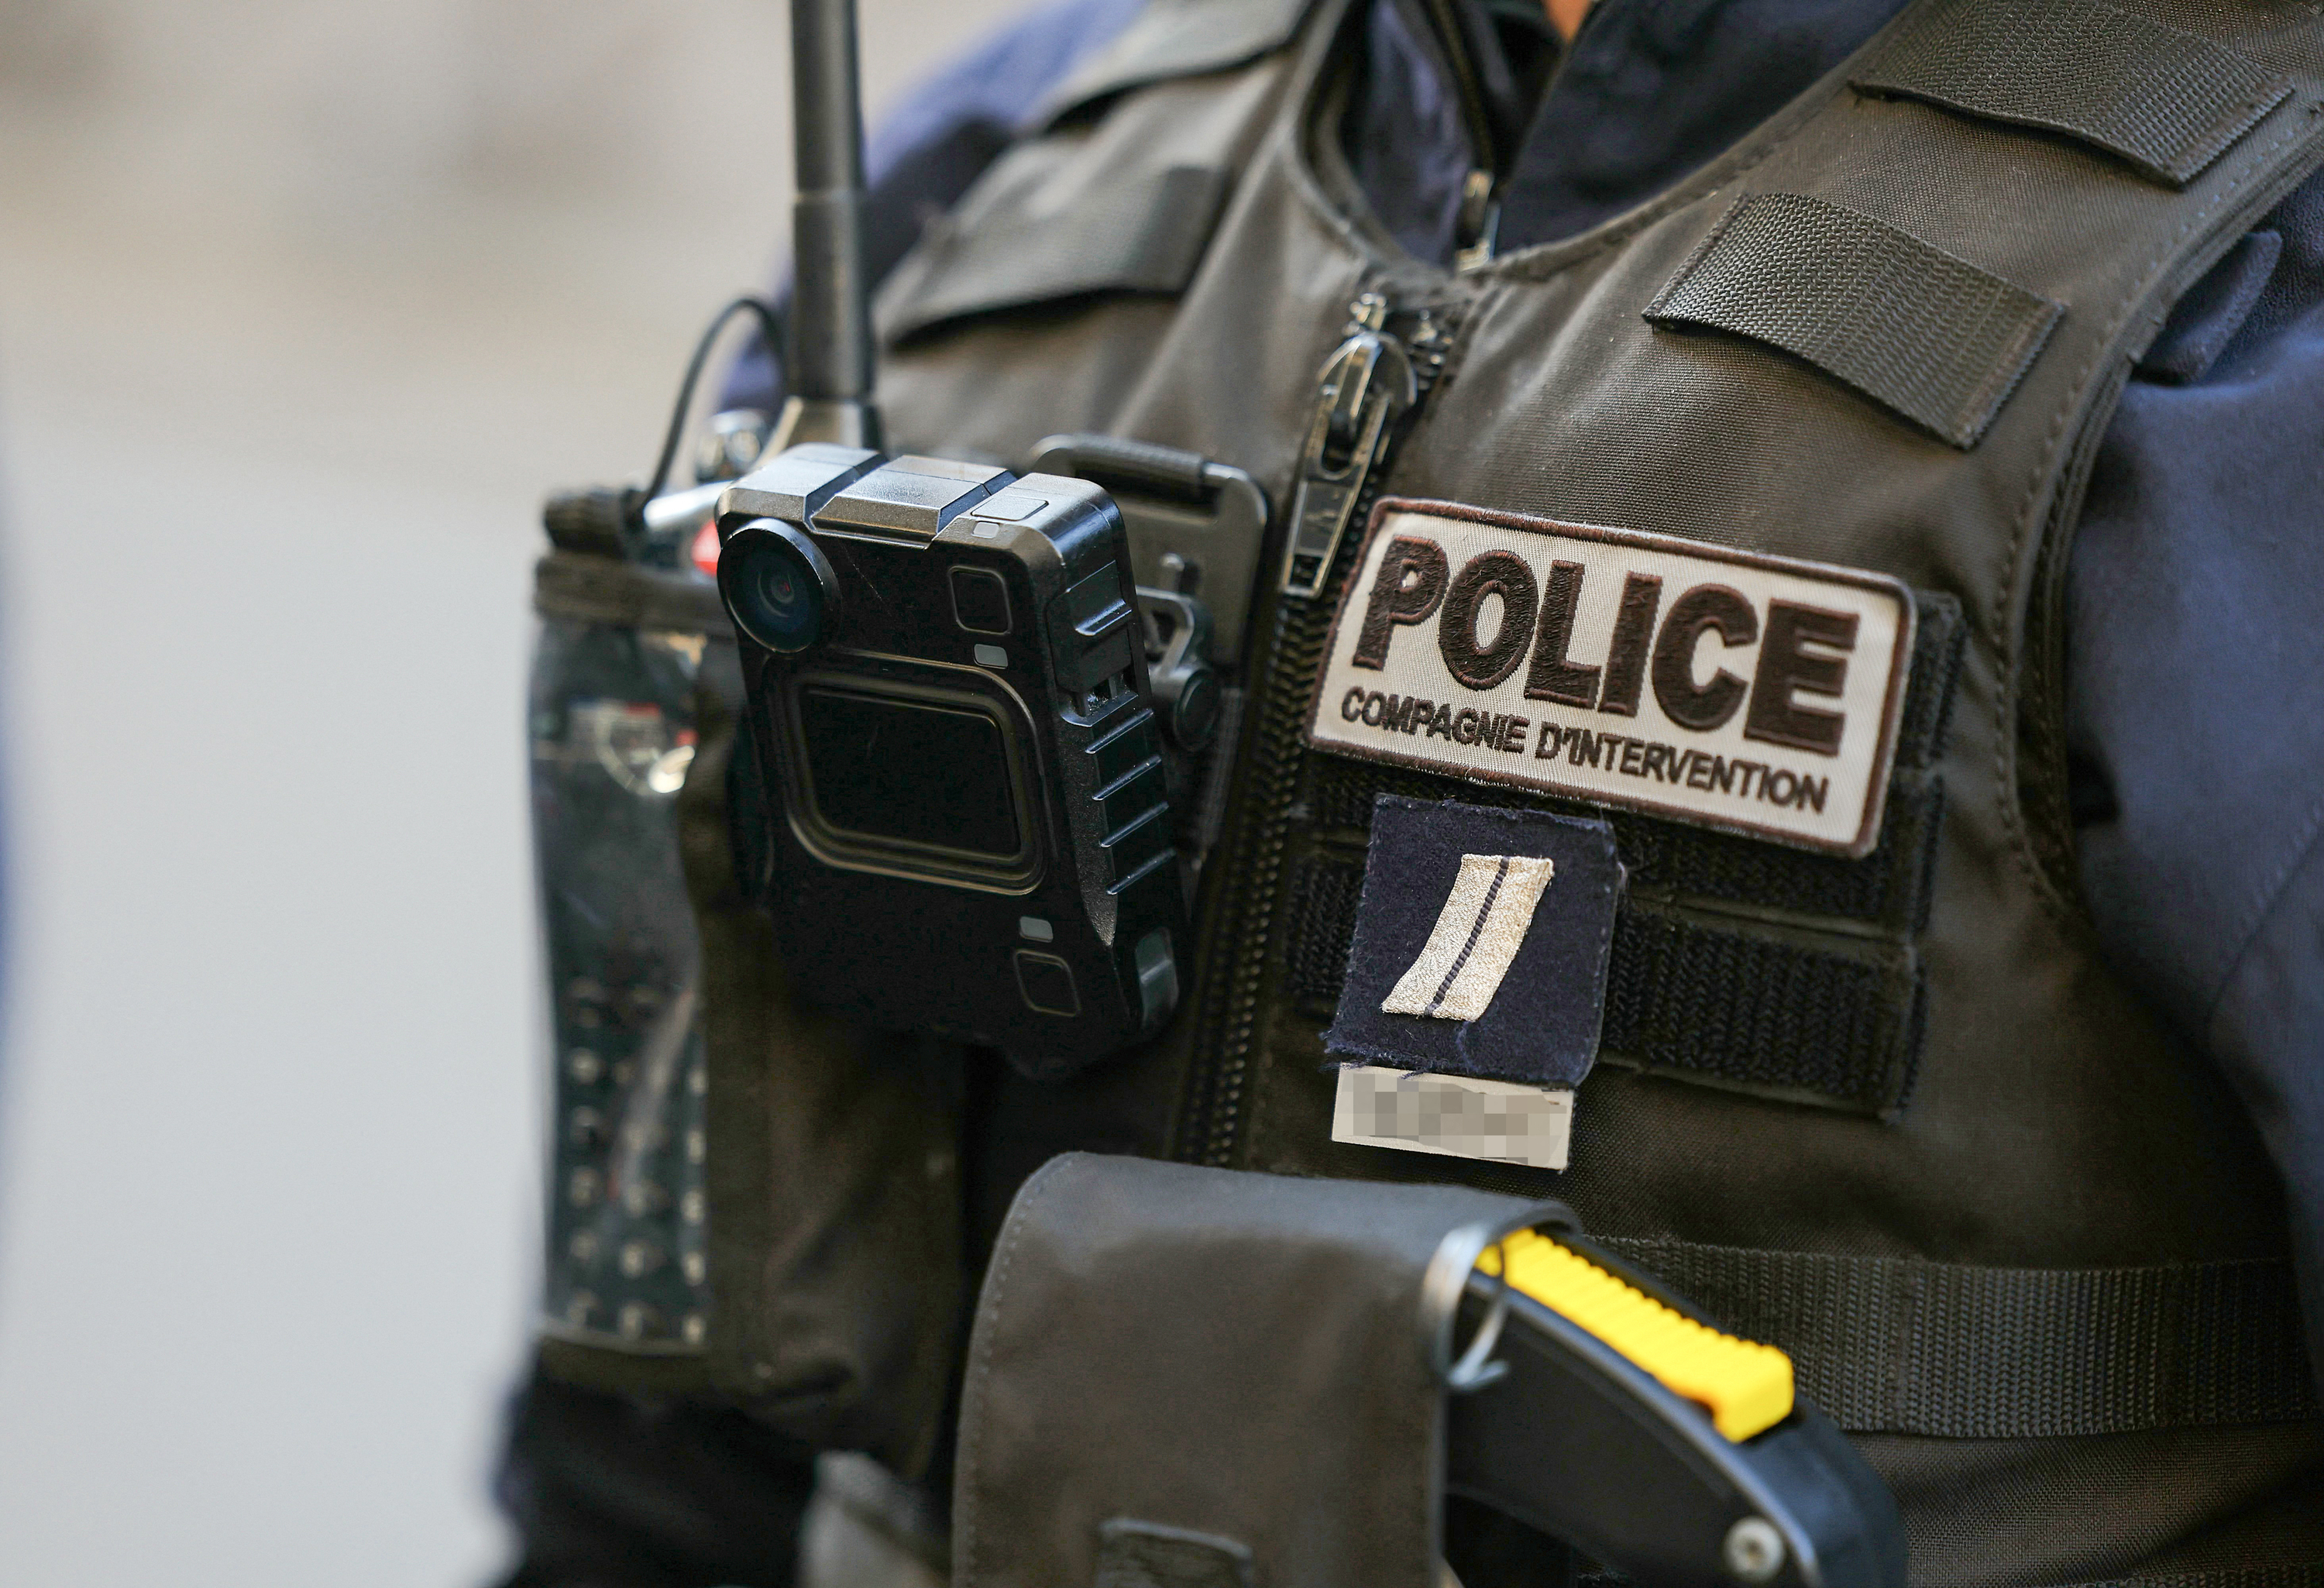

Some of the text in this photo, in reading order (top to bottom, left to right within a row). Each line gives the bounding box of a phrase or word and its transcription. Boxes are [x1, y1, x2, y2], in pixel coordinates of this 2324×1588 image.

[1352, 535, 1859, 756] POLICE
[1341, 686, 1830, 813] COMPAGNIE D'INTERVENTION
